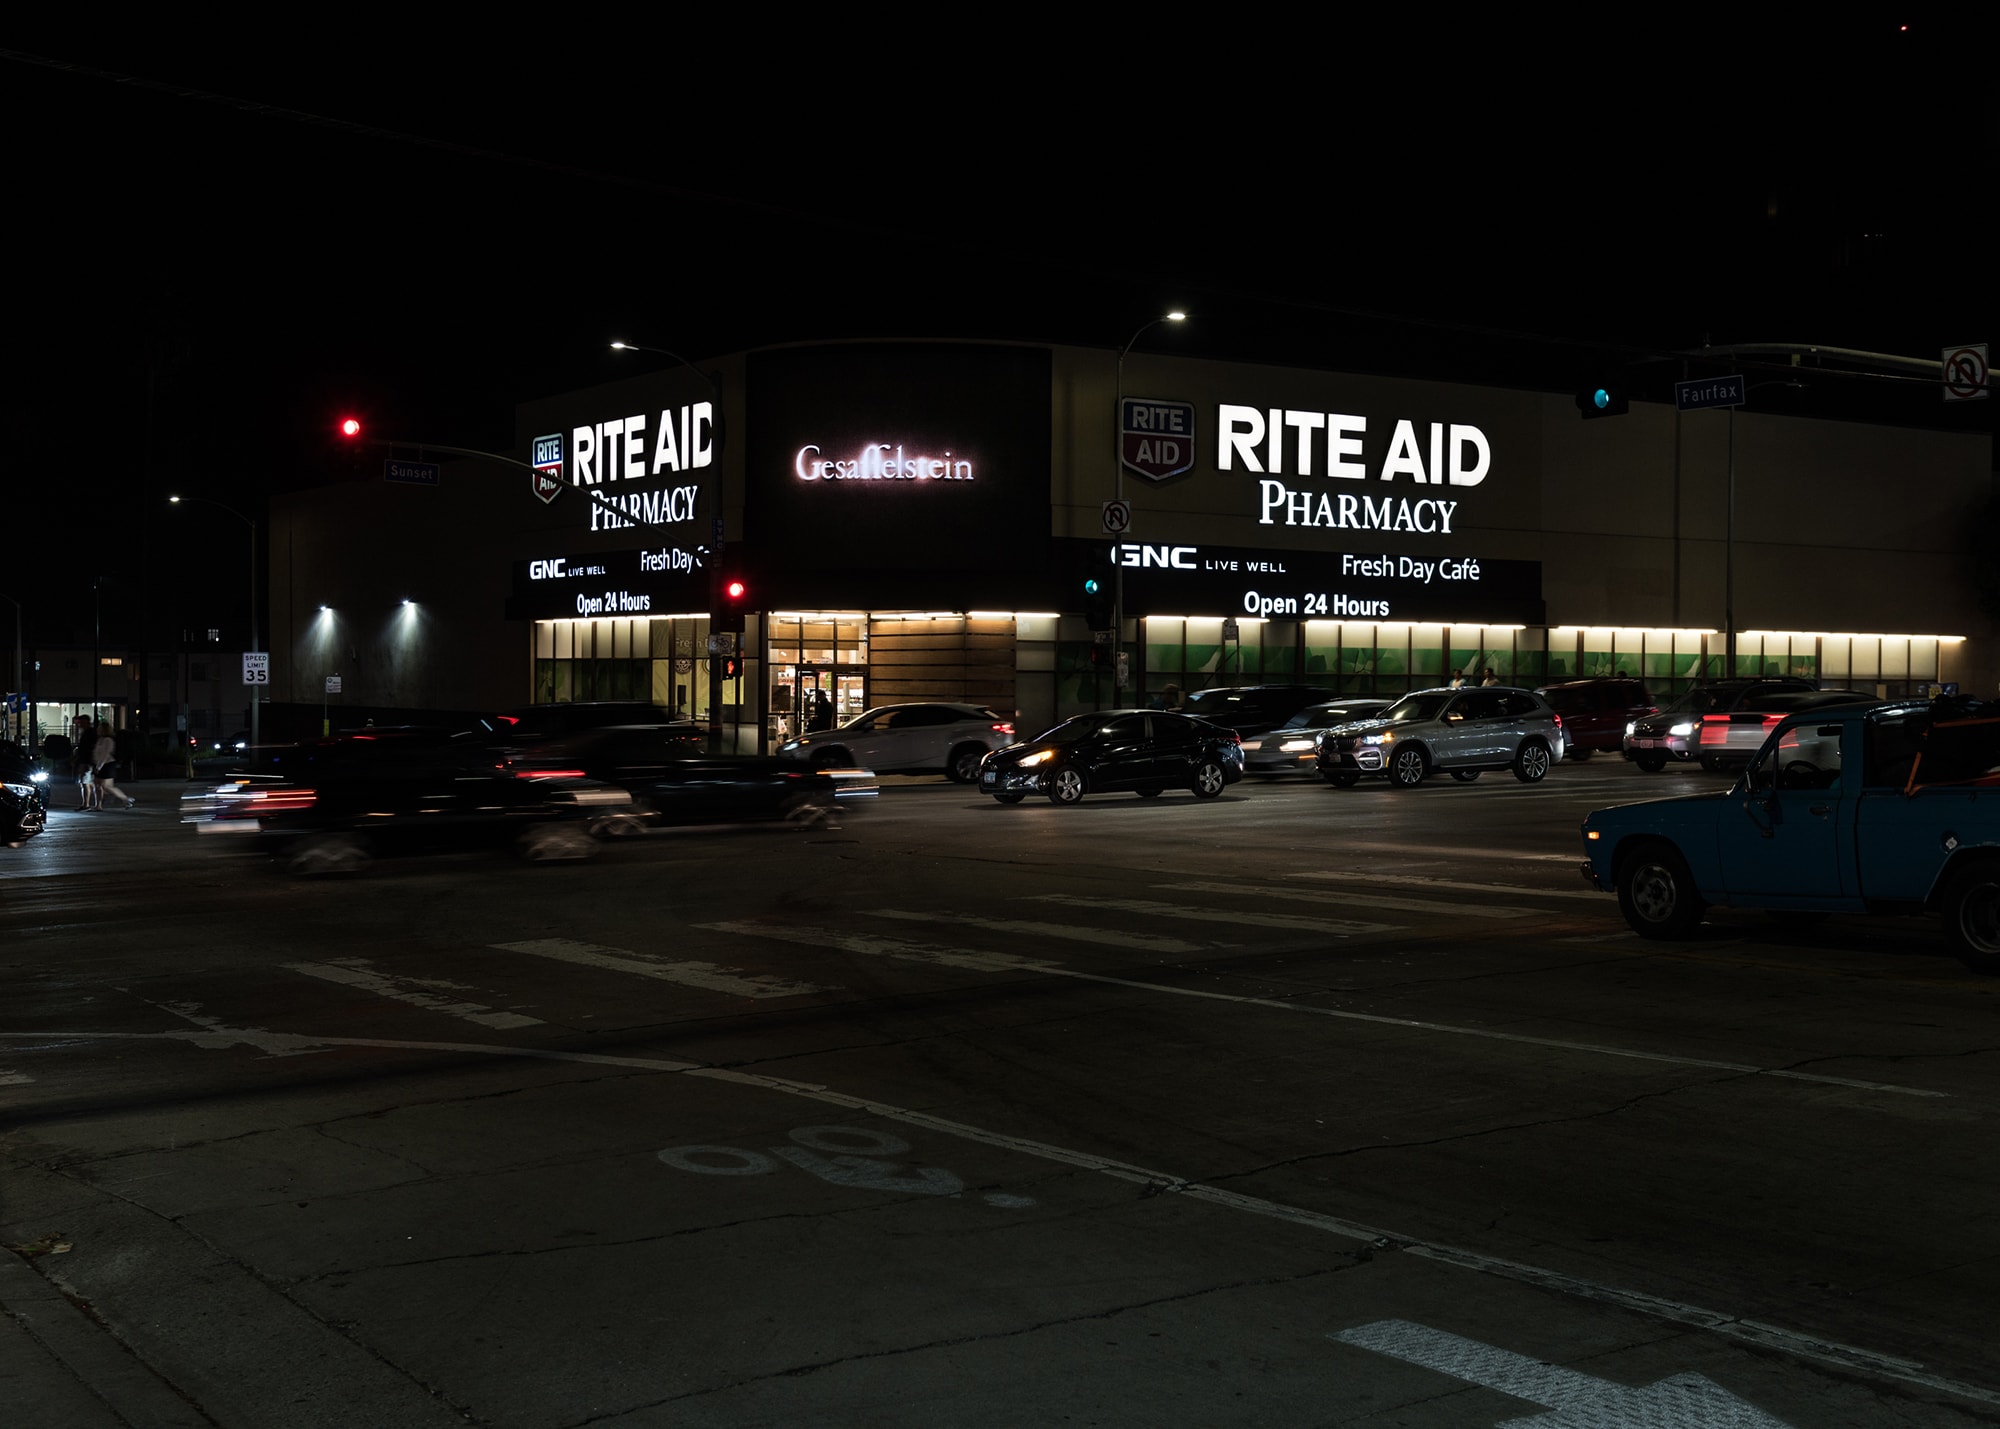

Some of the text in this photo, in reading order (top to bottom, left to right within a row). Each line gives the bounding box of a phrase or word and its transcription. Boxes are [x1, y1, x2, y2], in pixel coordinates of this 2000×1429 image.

[1682, 385, 1736, 403] Fairfax
[1132, 406, 1184, 432] RITE
[537, 440, 560, 463] RITE
[573, 401, 712, 487] RITE AID
[1135, 439, 1180, 465] AID
[1217, 404, 1490, 487] RITE AID
[391, 464, 433, 480] Sunset
[796, 444, 974, 481] Gesaffelstein
[539, 467, 558, 491] AID
[1259, 480, 1457, 534] PHARMACY
[529, 558, 606, 580] GNC LIVE WELL
[641, 547, 670, 572] Fresh
[672, 548, 693, 574] Day
[1111, 544, 1286, 573] GNC LIVE WELL
[1342, 554, 1480, 584] Fresh Day Café
[577, 591, 650, 617] Open 24 Hours
[1244, 591, 1390, 617] Open 24 Hours
[246, 670, 266, 682] 35
